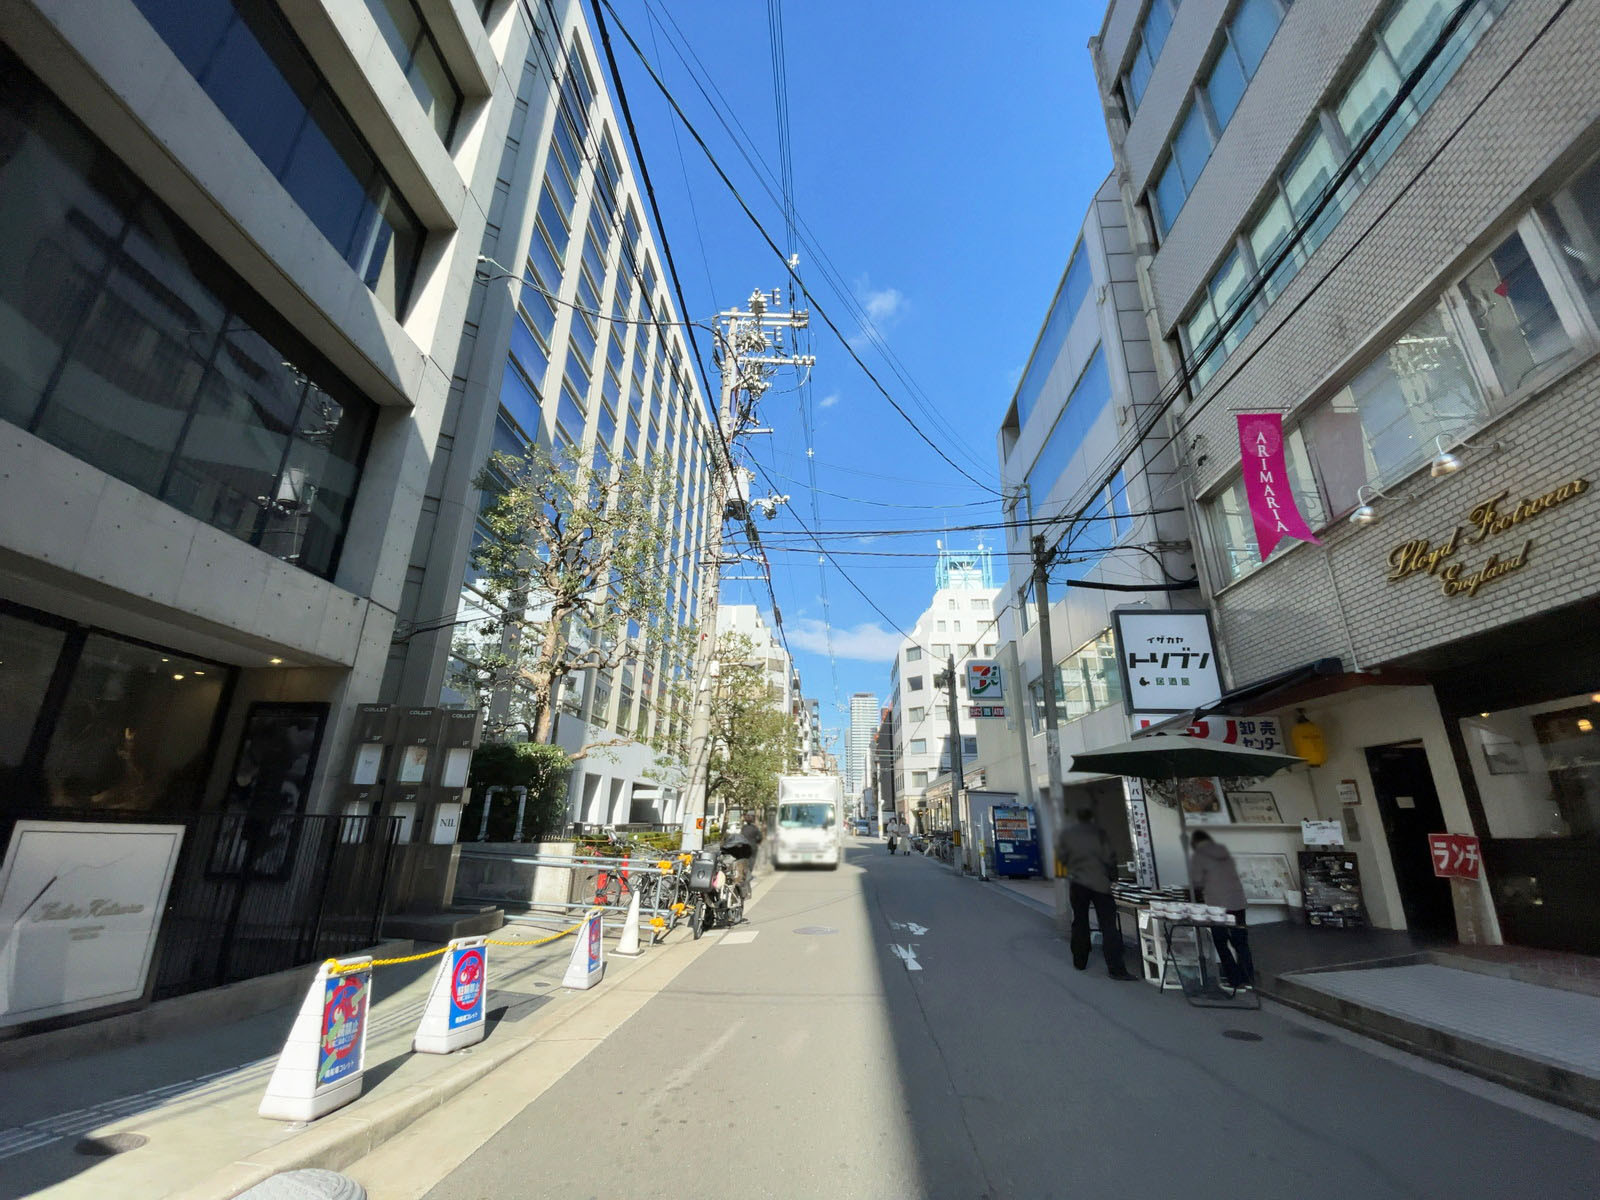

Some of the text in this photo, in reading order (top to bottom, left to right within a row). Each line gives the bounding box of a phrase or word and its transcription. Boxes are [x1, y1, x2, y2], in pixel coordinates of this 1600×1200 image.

[1256, 432, 1289, 532] ARIMARIA
[1387, 478, 1590, 583] Lloyd Footwear
[1440, 539, 1532, 597] England
[1147, 635, 1184, 644] イザカヤ
[1129, 647, 1210, 669] トリブン
[1156, 677, 1190, 686] 居酒屋
[1239, 720, 1276, 736] 卸売
[1434, 842, 1479, 871] ランチ
